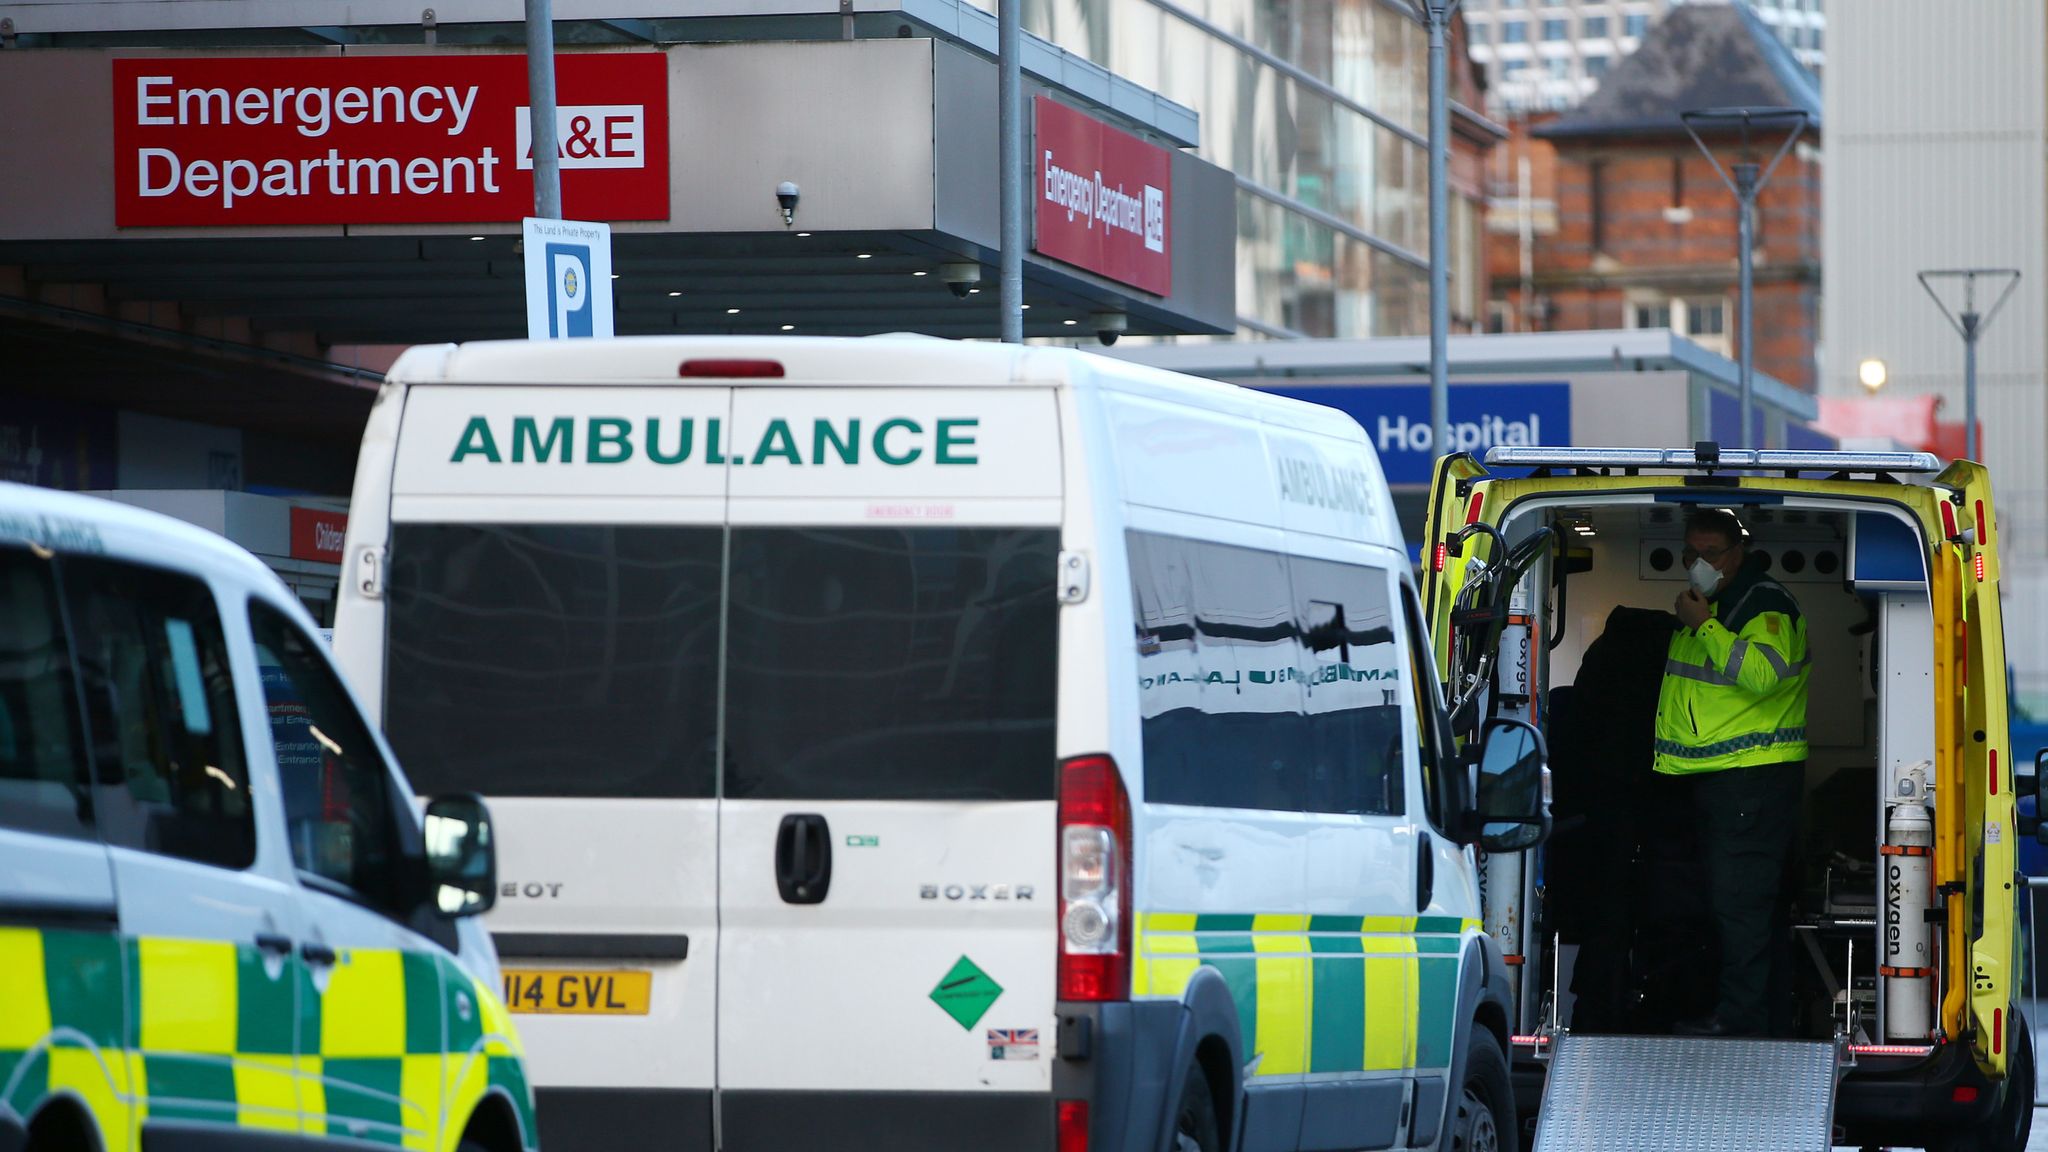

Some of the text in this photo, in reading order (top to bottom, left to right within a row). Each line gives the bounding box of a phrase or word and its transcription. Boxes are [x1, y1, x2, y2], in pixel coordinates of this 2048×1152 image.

[137, 76, 479, 136] Emergency
[526, 115, 636, 159] &E
[138, 147, 499, 208] Department
[1045, 150, 1094, 229] Emergency
[1095, 169, 1143, 235] Department
[534, 224, 543, 234] This
[544, 225, 556, 235] Land
[562, 226, 578, 237] Private
[580, 227, 600, 240] Property
[450, 416, 980, 467] AMBULANCE
[1377, 413, 1540, 452] Hospital
[1277, 455, 1375, 516] AMBULANCE
[316, 521, 345, 552] Children'
[1516, 638, 1527, 694] oxyge
[501, 882, 563, 898] EOT
[920, 884, 1034, 900] BOXER
[1888, 865, 1901, 955] oxygen
[557, 976, 626, 1008] GVL
